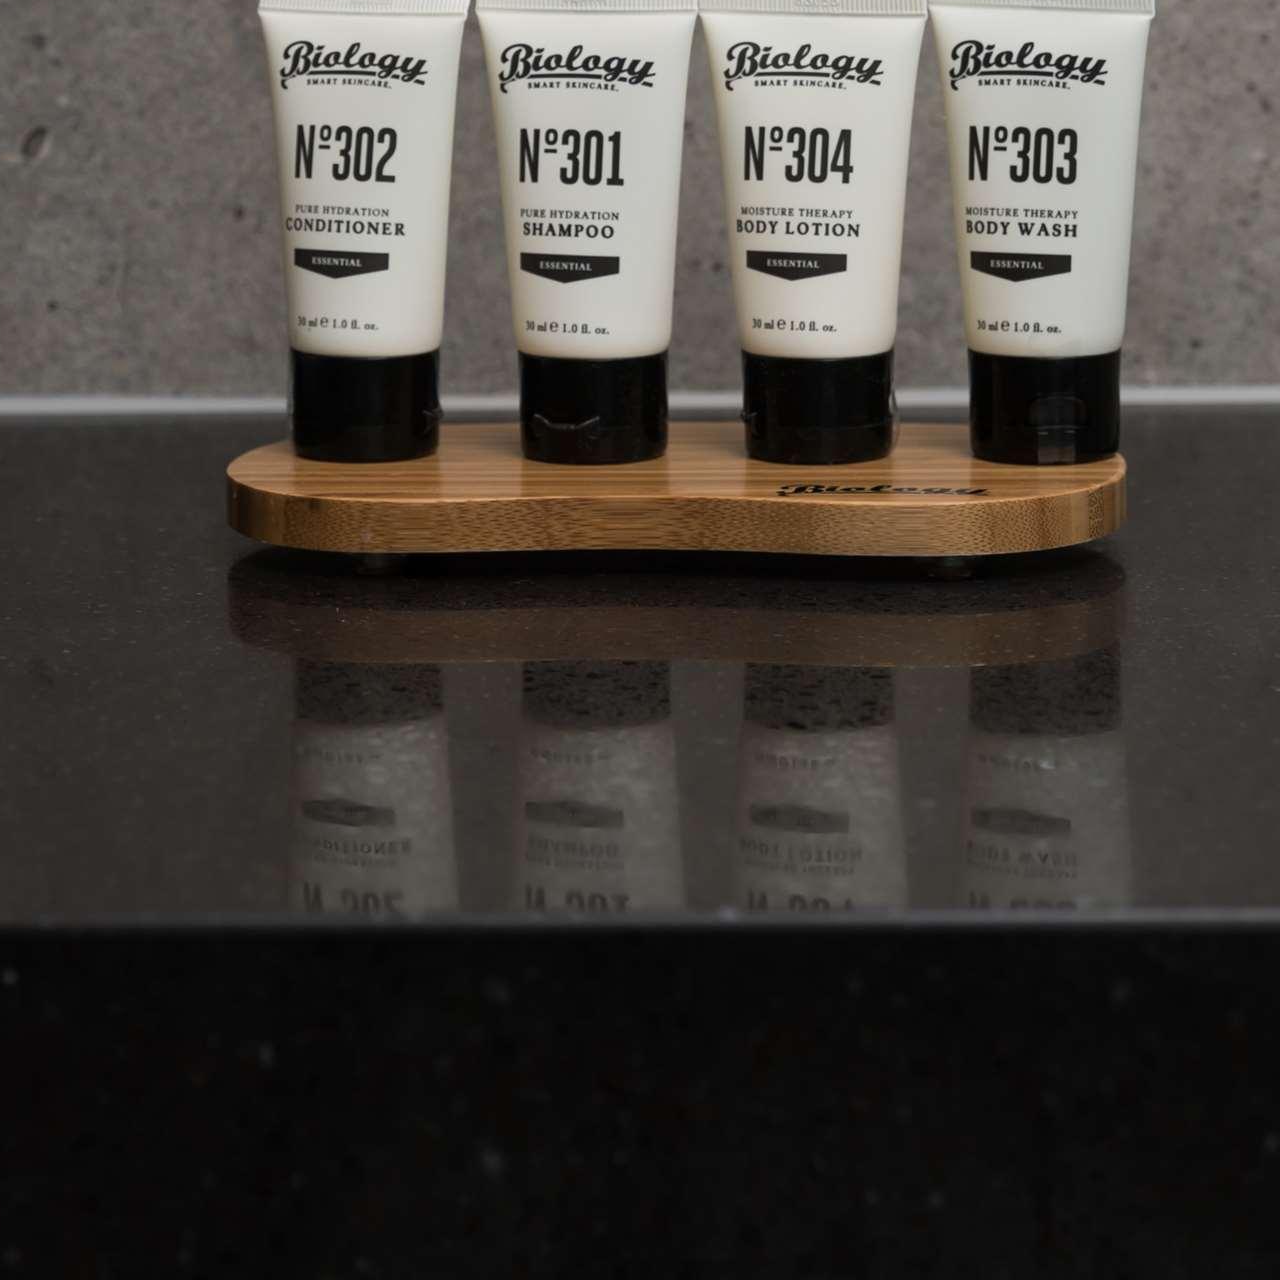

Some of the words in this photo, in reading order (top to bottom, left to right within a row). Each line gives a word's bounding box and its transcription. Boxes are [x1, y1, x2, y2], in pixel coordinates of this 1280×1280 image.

[280, 40, 428, 89] Biology
[498, 43, 656, 94] Biology
[723, 41, 884, 92] Biology
[949, 39, 1108, 91] Biology
[306, 78, 337, 86] SMART
[527, 81, 561, 90] SMART
[754, 79, 788, 88] SMART
[978, 79, 1011, 87] SMART
[295, 204, 318, 214] PURE
[322, 205, 390, 217] HYDRATION
[520, 208, 546, 219] PURE
[550, 210, 620, 221] HYDRATION
[740, 206, 795, 217] MOISTURE
[798, 208, 854, 219] THERAPY
[965, 207, 1019, 217] MOISTURE
[1023, 209, 1078, 219] THERAPY
[285, 217, 406, 236] CONDITIONER
[522, 222, 615, 239] SHAMPOO
[736, 219, 779, 235] BODY
[785, 221, 861, 238] LOTION
[966, 220, 1010, 235] BODY
[1018, 222, 1078, 238] WASH
[311, 256, 363, 267] ESSENTIAL
[539, 261, 592, 272] ESSENTIAL
[766, 258, 820, 269] ESSENTIAL
[990, 259, 1044, 270] ESSENTIAL
[297, 316, 306, 327] 30
[308, 317, 317, 327] ml
[332, 318, 348, 329] 1.0
[351, 319, 360, 330] fl.
[364, 322, 379, 331] oz.
[525, 320, 535, 331] 30
[537, 322, 547, 332] ml
[562, 323, 578, 334] 1.0
[581, 324, 591, 334] fl.
[594, 327, 610, 335] oz.
[752, 318, 762, 329] 30
[764, 319, 774, 330] ml
[790, 321, 806, 331] 1.0
[809, 321, 819, 332] fl.
[822, 324, 837, 332] oz.
[977, 319, 986, 330] 30
[988, 321, 998, 331] ml
[1014, 322, 1030, 333] 1.0
[1033, 322, 1043, 333] fl.
[1047, 326, 1062, 334] oz.
[776, 484, 989, 497] Biology
